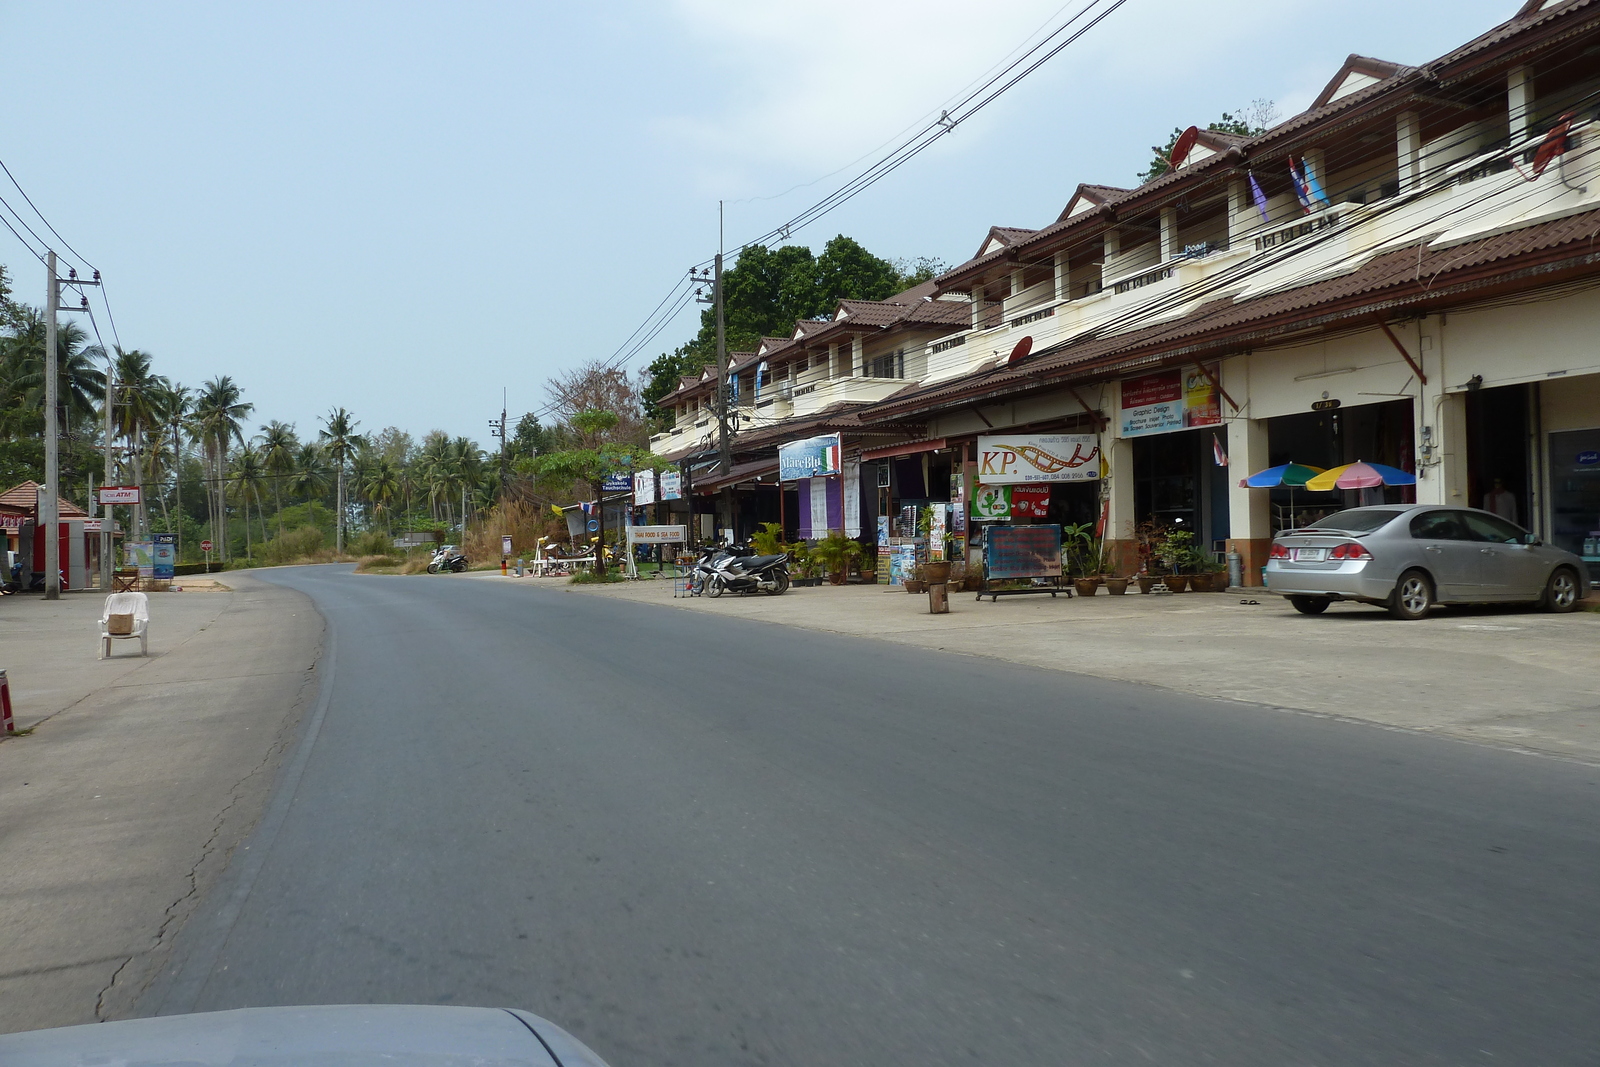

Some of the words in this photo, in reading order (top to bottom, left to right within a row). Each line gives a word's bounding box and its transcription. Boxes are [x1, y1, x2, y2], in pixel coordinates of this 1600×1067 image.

[1133, 407, 1152, 417] Graphic
[1153, 405, 1170, 415] Design
[1162, 413, 1175, 421] Photo
